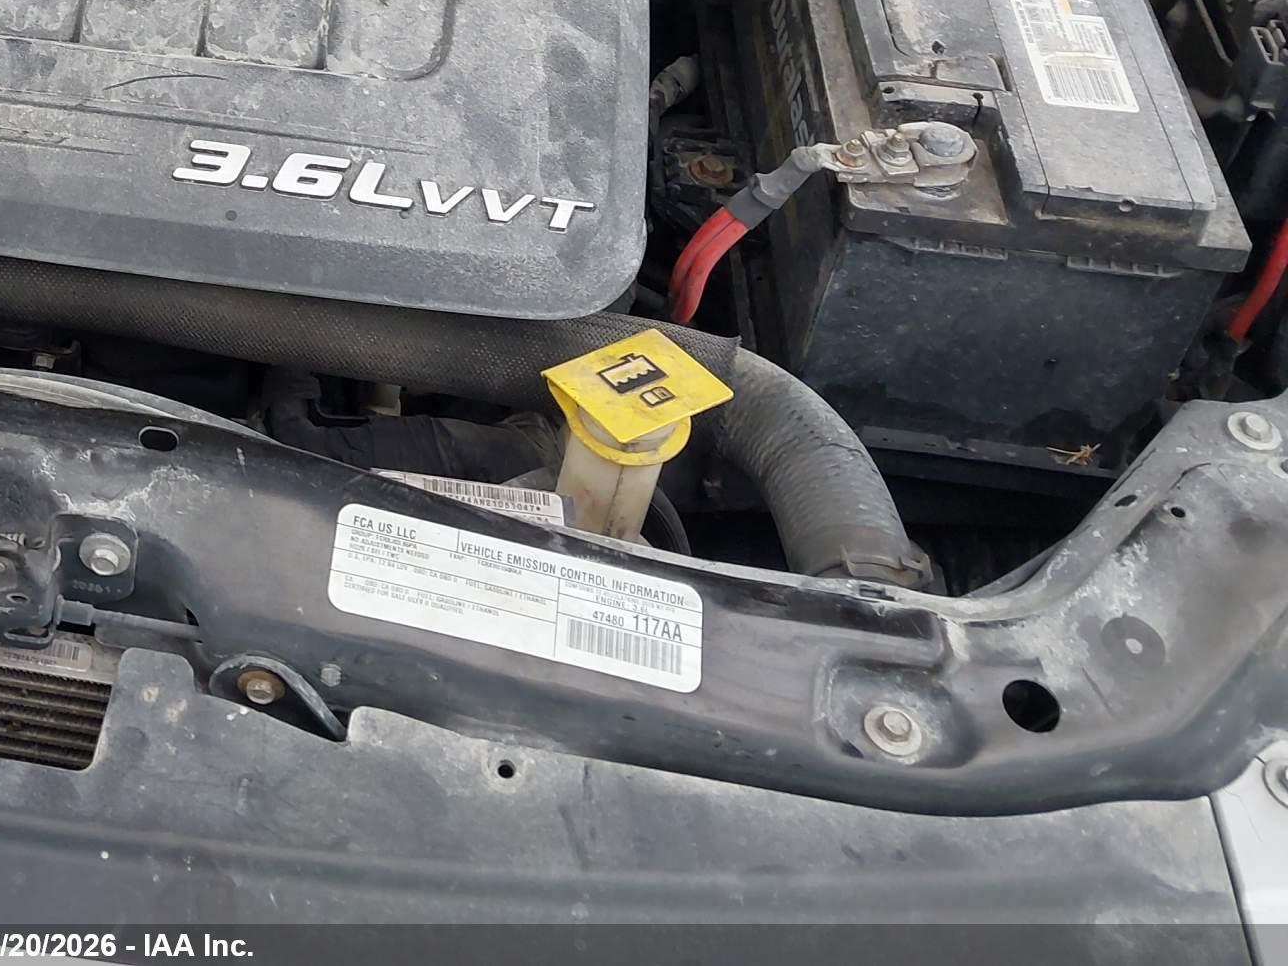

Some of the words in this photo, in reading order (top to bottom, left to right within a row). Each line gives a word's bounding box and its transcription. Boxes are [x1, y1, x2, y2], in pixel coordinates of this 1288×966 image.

[352, 515, 374, 529] FCA
[377, 521, 392, 533] US
[396, 525, 416, 539] LLC
[460, 541, 502, 560] VEHICLE
[507, 553, 555, 574] EMISSION
[560, 566, 608, 587] CONTROL
[612, 578, 683, 606] INFORMATION
[592, 610, 624, 627] 47480
[632, 613, 682, 641] 117AA
